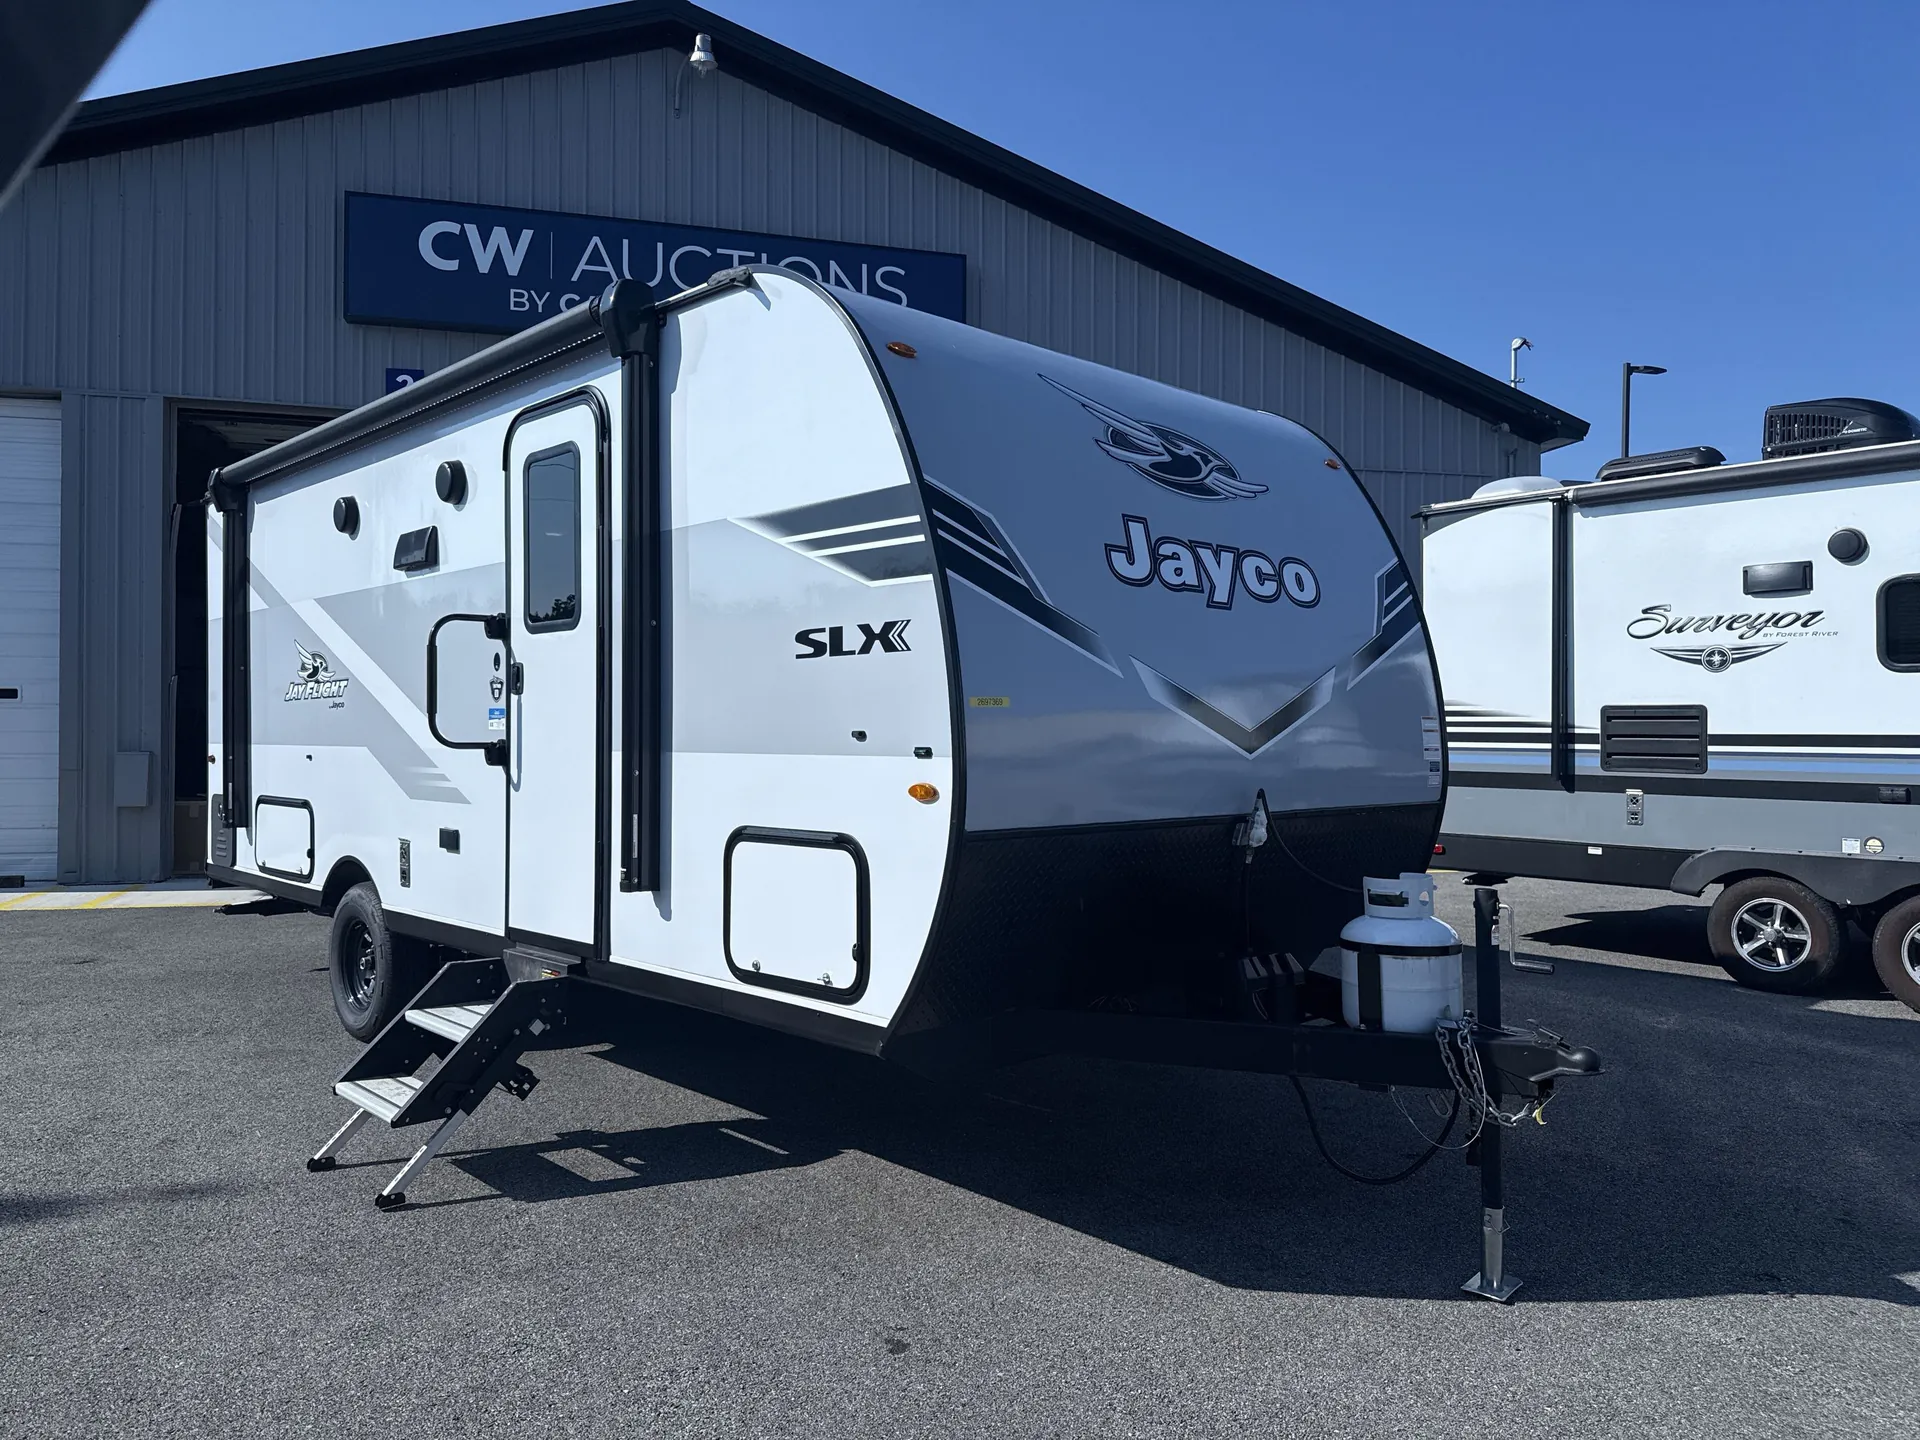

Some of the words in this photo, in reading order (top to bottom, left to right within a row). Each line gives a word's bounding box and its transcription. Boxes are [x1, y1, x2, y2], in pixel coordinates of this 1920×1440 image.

[418, 220, 535, 276] CW
[509, 288, 551, 313] BY
[1104, 513, 1321, 611] Jayco
[794, 618, 912, 660] SLX
[1626, 603, 1826, 641] Surveyor
[283, 682, 307, 702] JAY
[303, 678, 349, 700] FLIGHT
